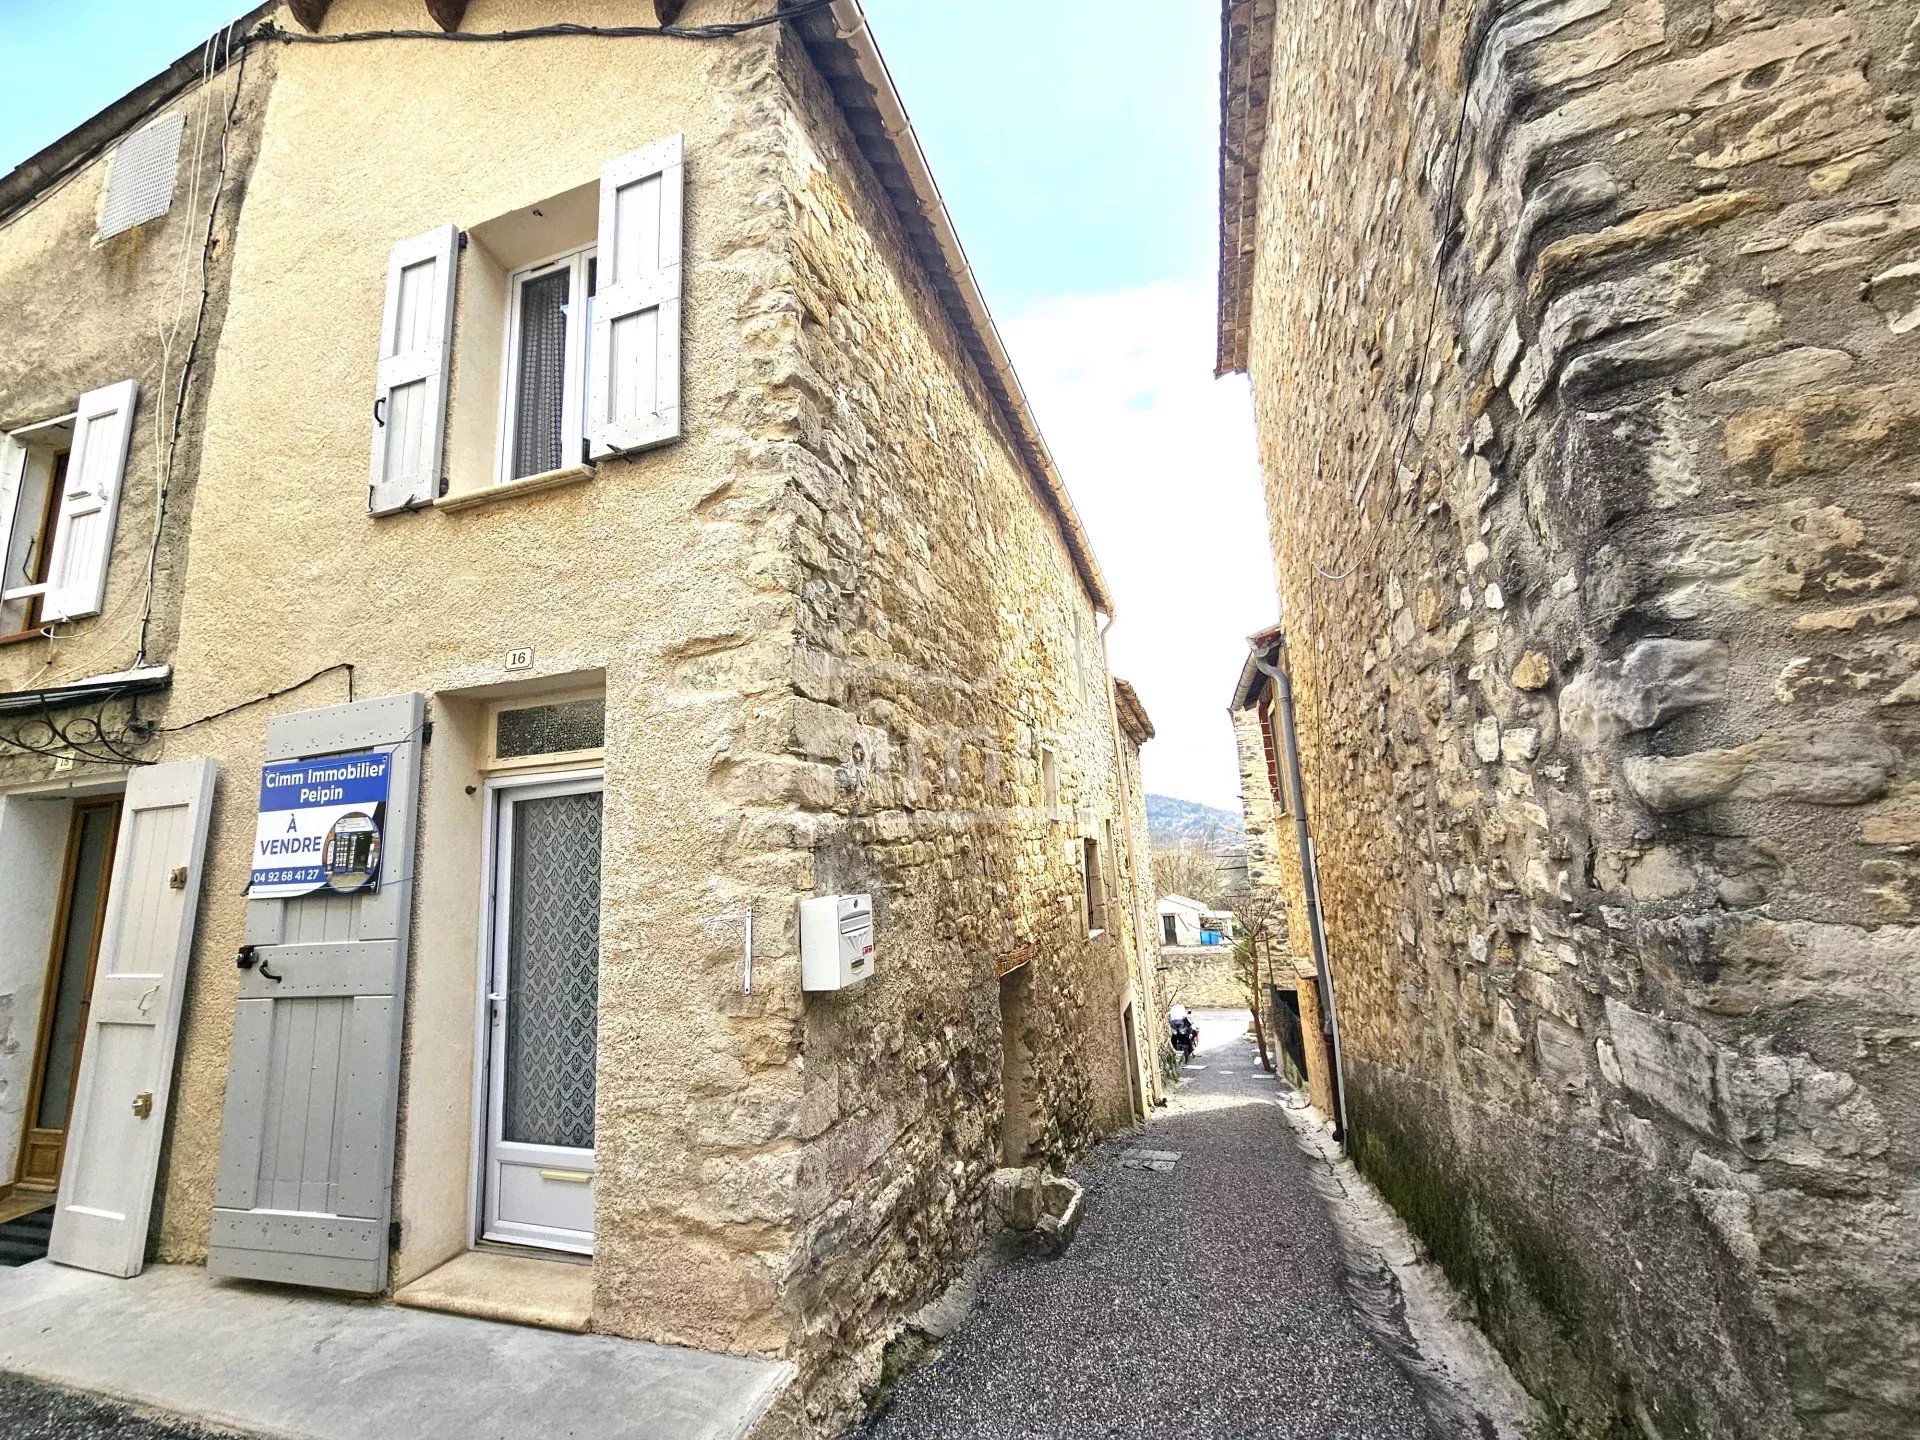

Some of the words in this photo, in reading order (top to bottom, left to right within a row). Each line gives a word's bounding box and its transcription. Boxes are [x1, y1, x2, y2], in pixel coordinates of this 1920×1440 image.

[511, 652, 526, 665] 16
[266, 772, 304, 788] Cimm
[307, 762, 386, 784] Immobilier
[300, 785, 343, 804] Peipin
[286, 813, 298, 833] À
[260, 836, 322, 856] VENDRE
[254, 872, 267, 883] 04
[268, 871, 280, 882] 92
[281, 870, 293, 882] 68
[294, 869, 305, 881] 41
[307, 868, 320, 880] 27
